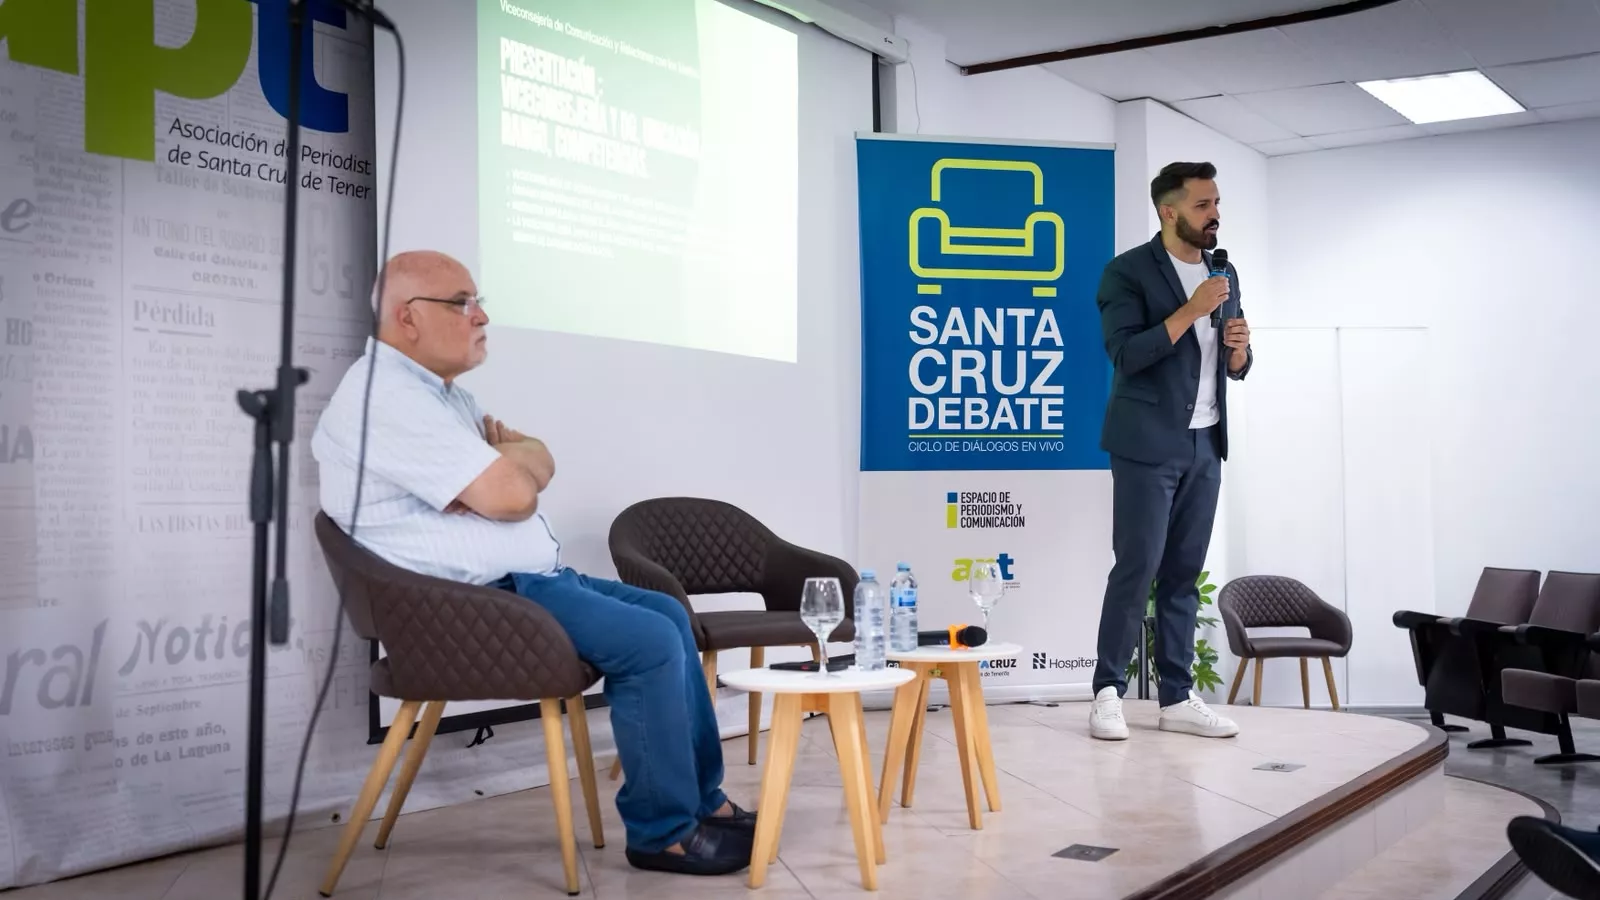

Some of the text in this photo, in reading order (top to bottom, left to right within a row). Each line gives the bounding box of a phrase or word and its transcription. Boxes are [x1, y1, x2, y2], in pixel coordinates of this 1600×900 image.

[168, 117, 268, 155] Asociación
[273, 138, 290, 158] d
[168, 144, 191, 166] de
[197, 151, 251, 178] Santa
[257, 163, 288, 184] Cru
[301, 171, 321, 191] de
[133, 298, 216, 328] Pérdida
[908, 305, 1064, 347] SANTA
[908, 348, 1064, 395] CRUZ
[908, 397, 1064, 430] DEBATE
[908, 439, 1064, 452] CICLO DE DIÁLOGOS EN VIVO
[960, 491, 1011, 503] ESPACIO DE
[960, 503, 1023, 516] PERIODISMO Y
[960, 513, 1025, 528] COMUNICACIÓN
[136, 731, 154, 747] de
[159, 728, 190, 744] este
[130, 753, 149, 768] de
[179, 741, 232, 762] Laguna
